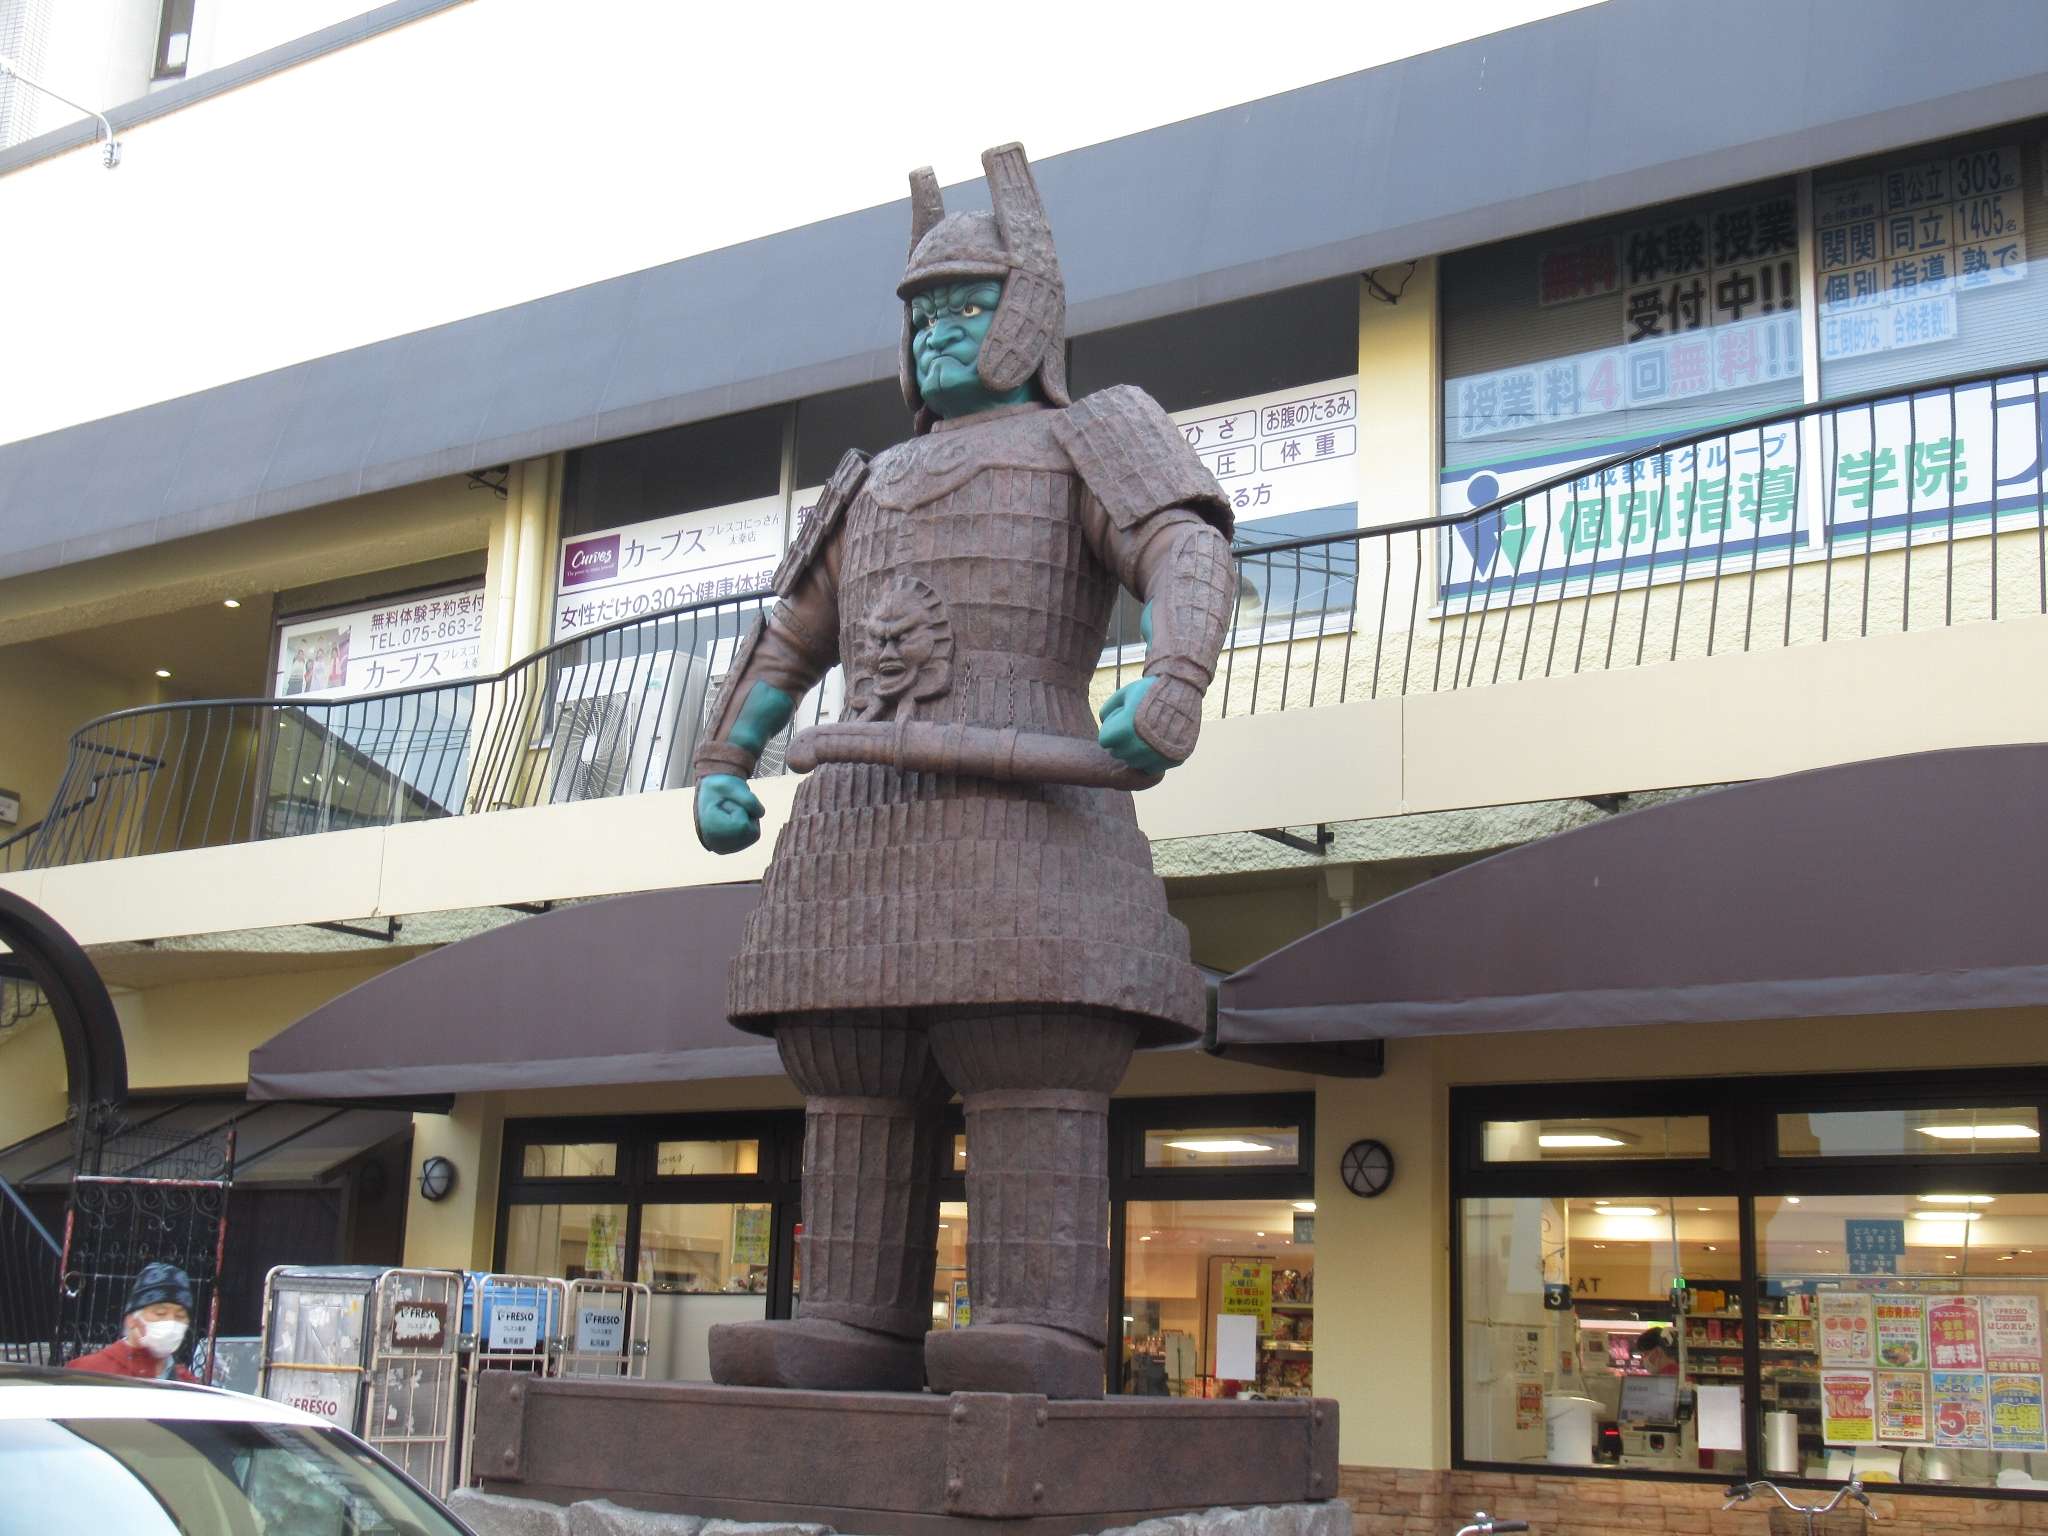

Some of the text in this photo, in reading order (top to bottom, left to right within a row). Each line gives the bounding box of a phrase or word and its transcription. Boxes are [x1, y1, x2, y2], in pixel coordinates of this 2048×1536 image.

[1959, 196, 2017, 241] 1405名
[1266, 396, 1351, 431] お腹のたるみ
[1186, 416, 1238, 446] ひざ
[1280, 432, 1336, 464] 体重
[1228, 483, 1273, 508] る方
[571, 550, 612, 569] Curves
[622, 528, 706, 569] カーブス
[371, 593, 485, 632] 無料体験予約受付
[363, 651, 441, 690] カーブス
[1550, 1288, 1562, 1306] 3
[593, 1315, 621, 1325] FRESCO
[294, 1397, 338, 1416] FRESCO
